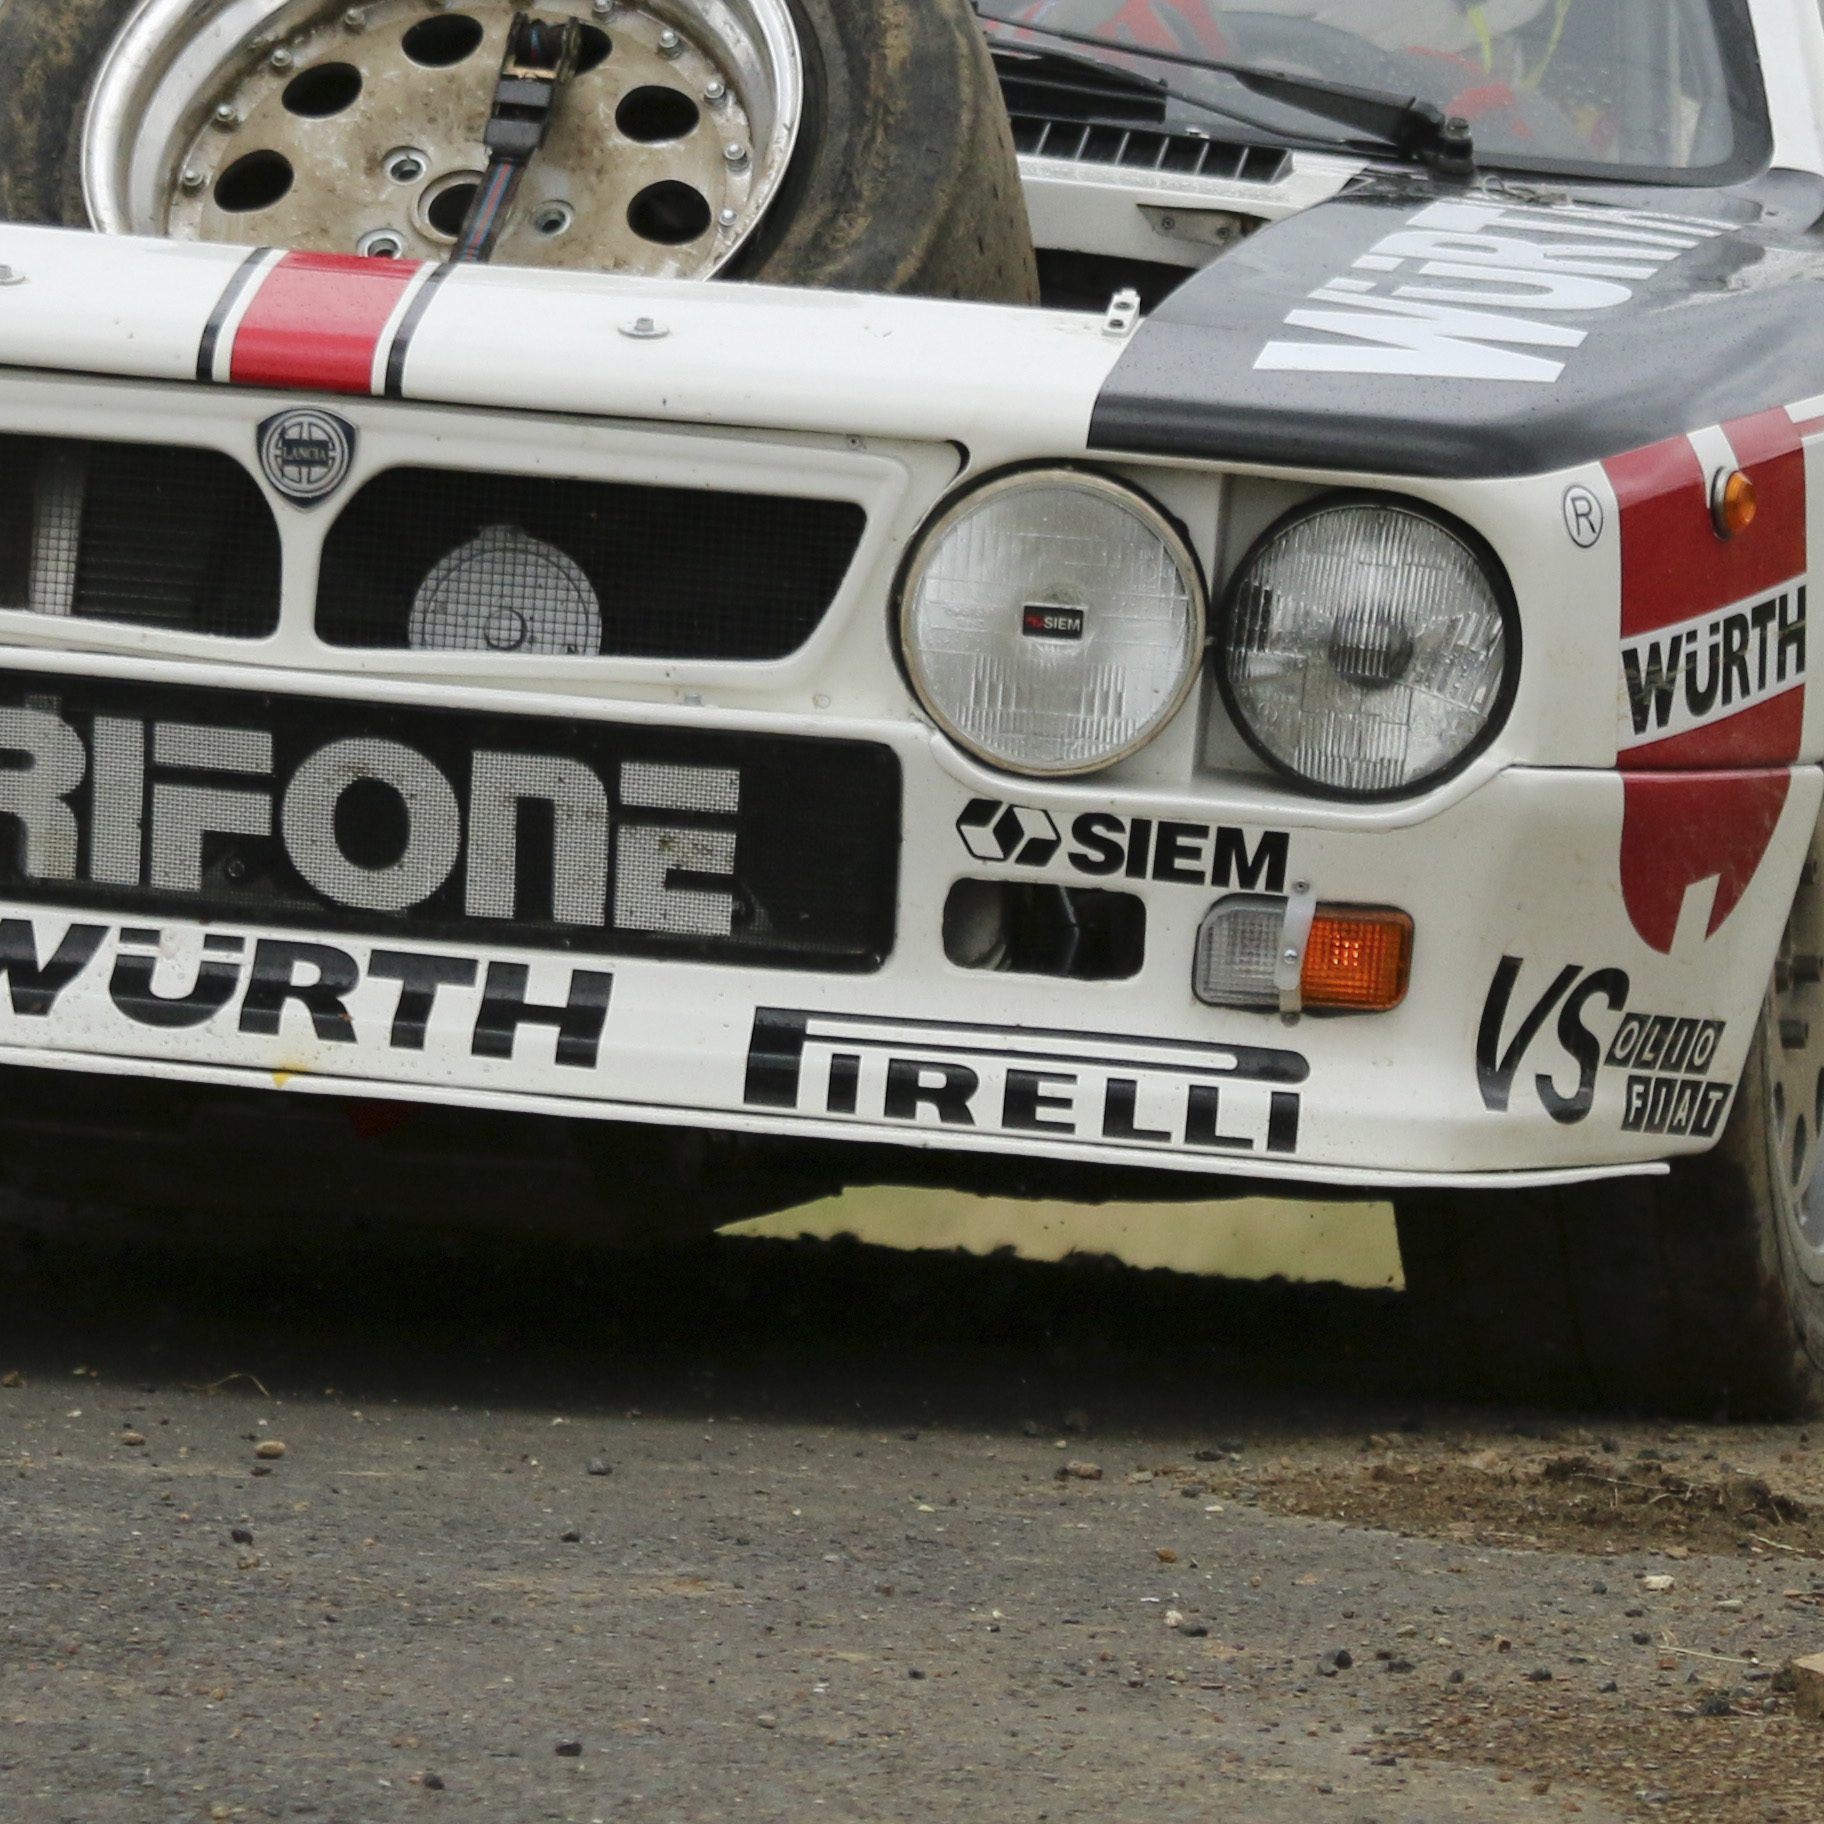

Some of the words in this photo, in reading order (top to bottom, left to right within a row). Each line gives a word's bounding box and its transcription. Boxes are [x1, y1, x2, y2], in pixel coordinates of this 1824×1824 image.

[1043, 617, 1081, 631] SIEM
[1621, 582, 1808, 736] WÜRTH
[1068, 813, 1289, 894] SIEM
[743, 1006, 1311, 1154] PIRELLI
[1476, 954, 1631, 1125] VS
[1607, 1013, 1724, 1073] OLIO
[1623, 1080, 1731, 1137] FIAT
